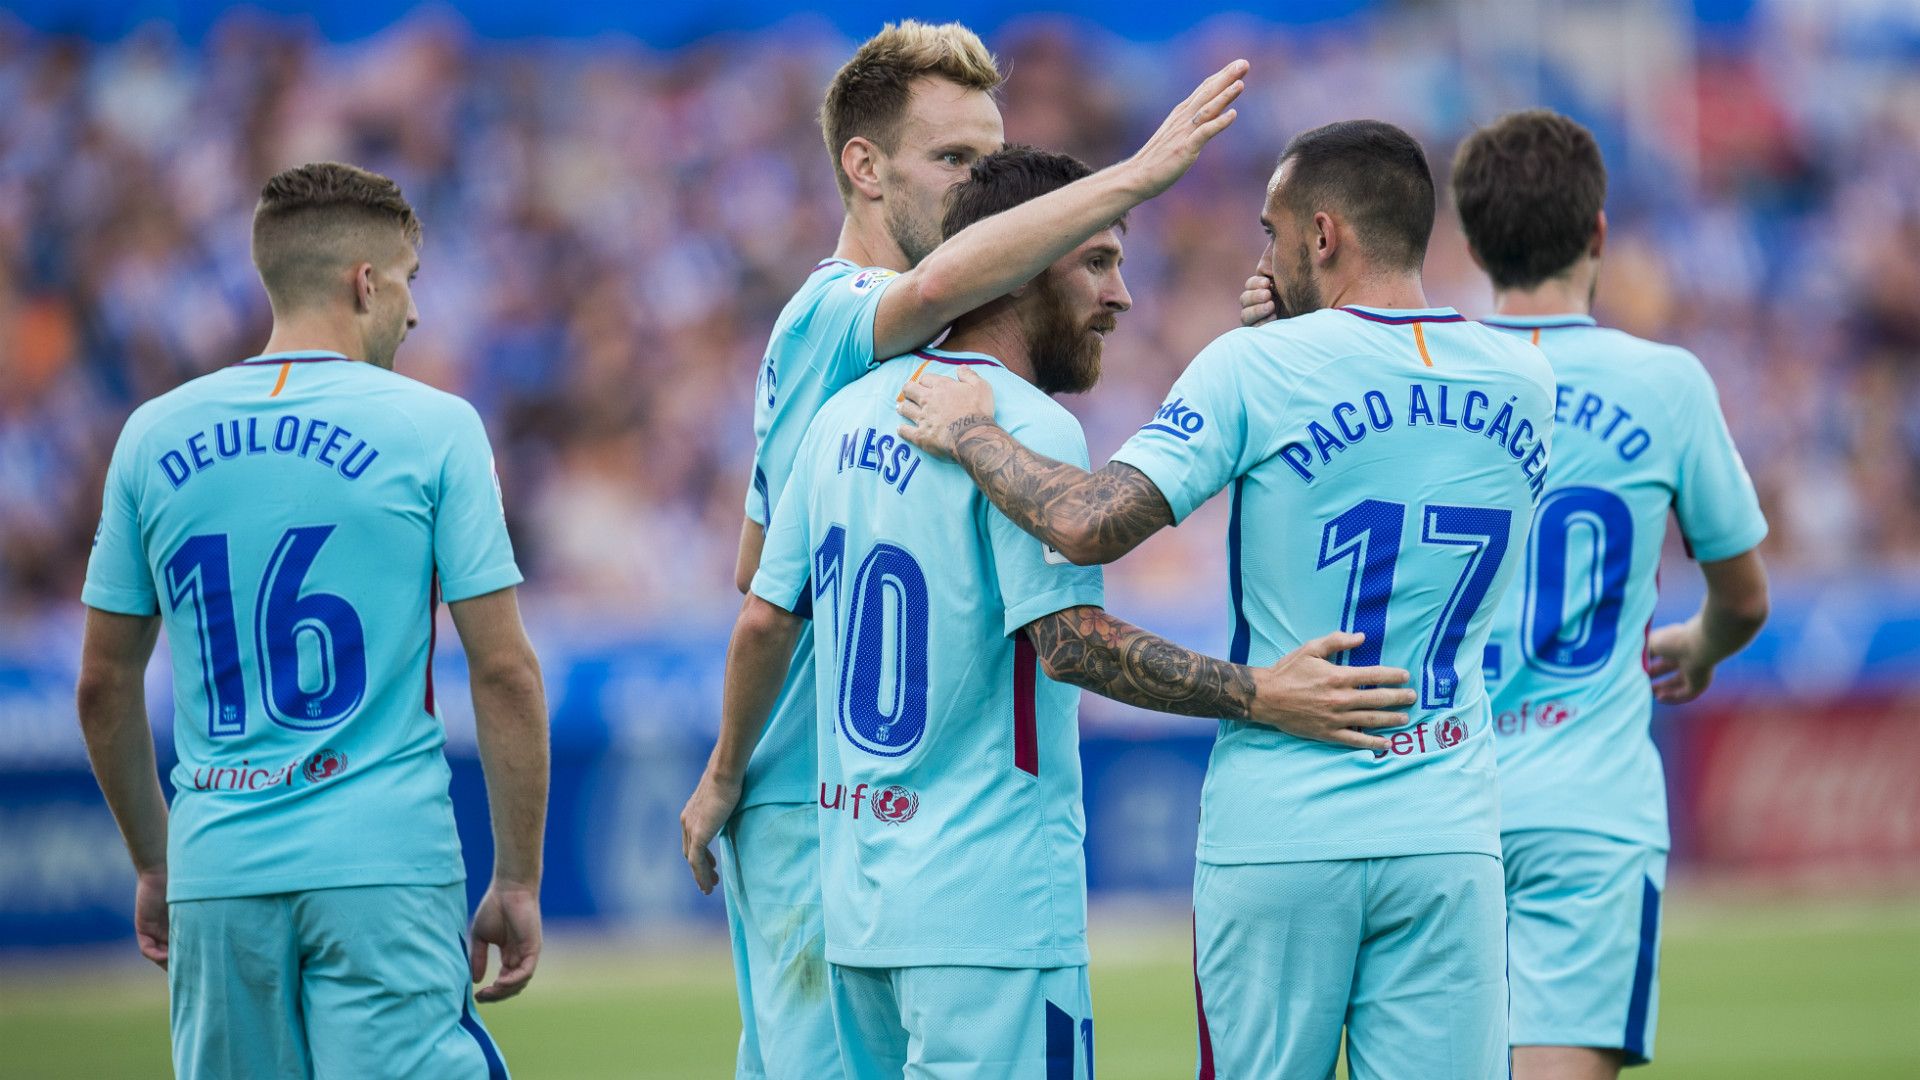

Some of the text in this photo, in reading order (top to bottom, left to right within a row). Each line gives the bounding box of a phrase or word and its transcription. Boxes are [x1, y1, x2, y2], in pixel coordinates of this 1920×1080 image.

[157, 415, 380, 491] DEULOFEU
[838, 427, 922, 495] MESSI
[1279, 390, 1394, 484] PACO
[163, 524, 367, 738] 16
[815, 524, 929, 758] 10
[1316, 498, 1513, 710] 17
[194, 756, 304, 791] unicef
